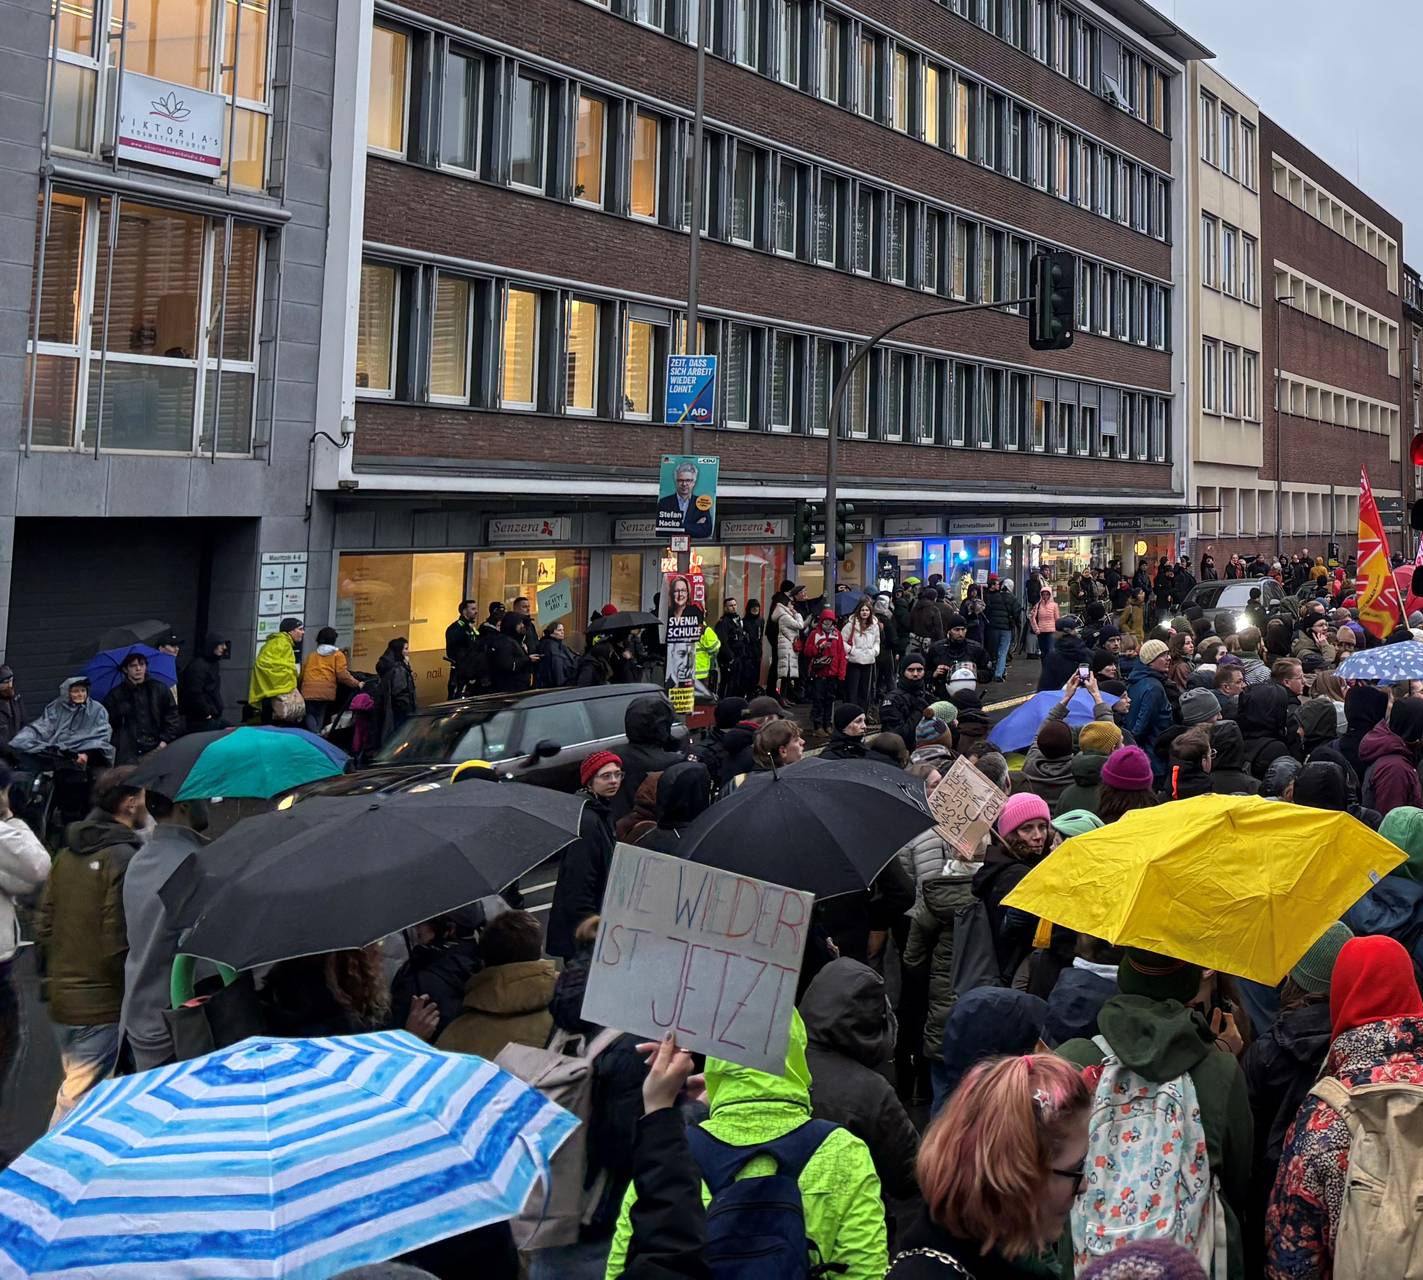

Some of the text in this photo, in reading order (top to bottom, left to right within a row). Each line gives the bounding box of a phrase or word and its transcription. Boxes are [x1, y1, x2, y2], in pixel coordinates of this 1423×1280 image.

[689, 359, 708, 367] DASS
[670, 367, 713, 376] SICH ARBEIT
[670, 376, 697, 384] WIEDER
[669, 385, 693, 393] LOHNT.
[691, 408, 708, 416] AfD
[493, 521, 539, 533] Senzera
[724, 521, 764, 532] Senzera
[692, 575, 703, 583] SPD
[668, 616, 699, 627] SVENJA
[667, 626, 702, 637] SCHULZE
[939, 779, 973, 827] WAS STEHT
[950, 814, 968, 837] DAS
[611, 856, 806, 955] NIE WIEDER
[596, 920, 798, 1056] IST JETZT
